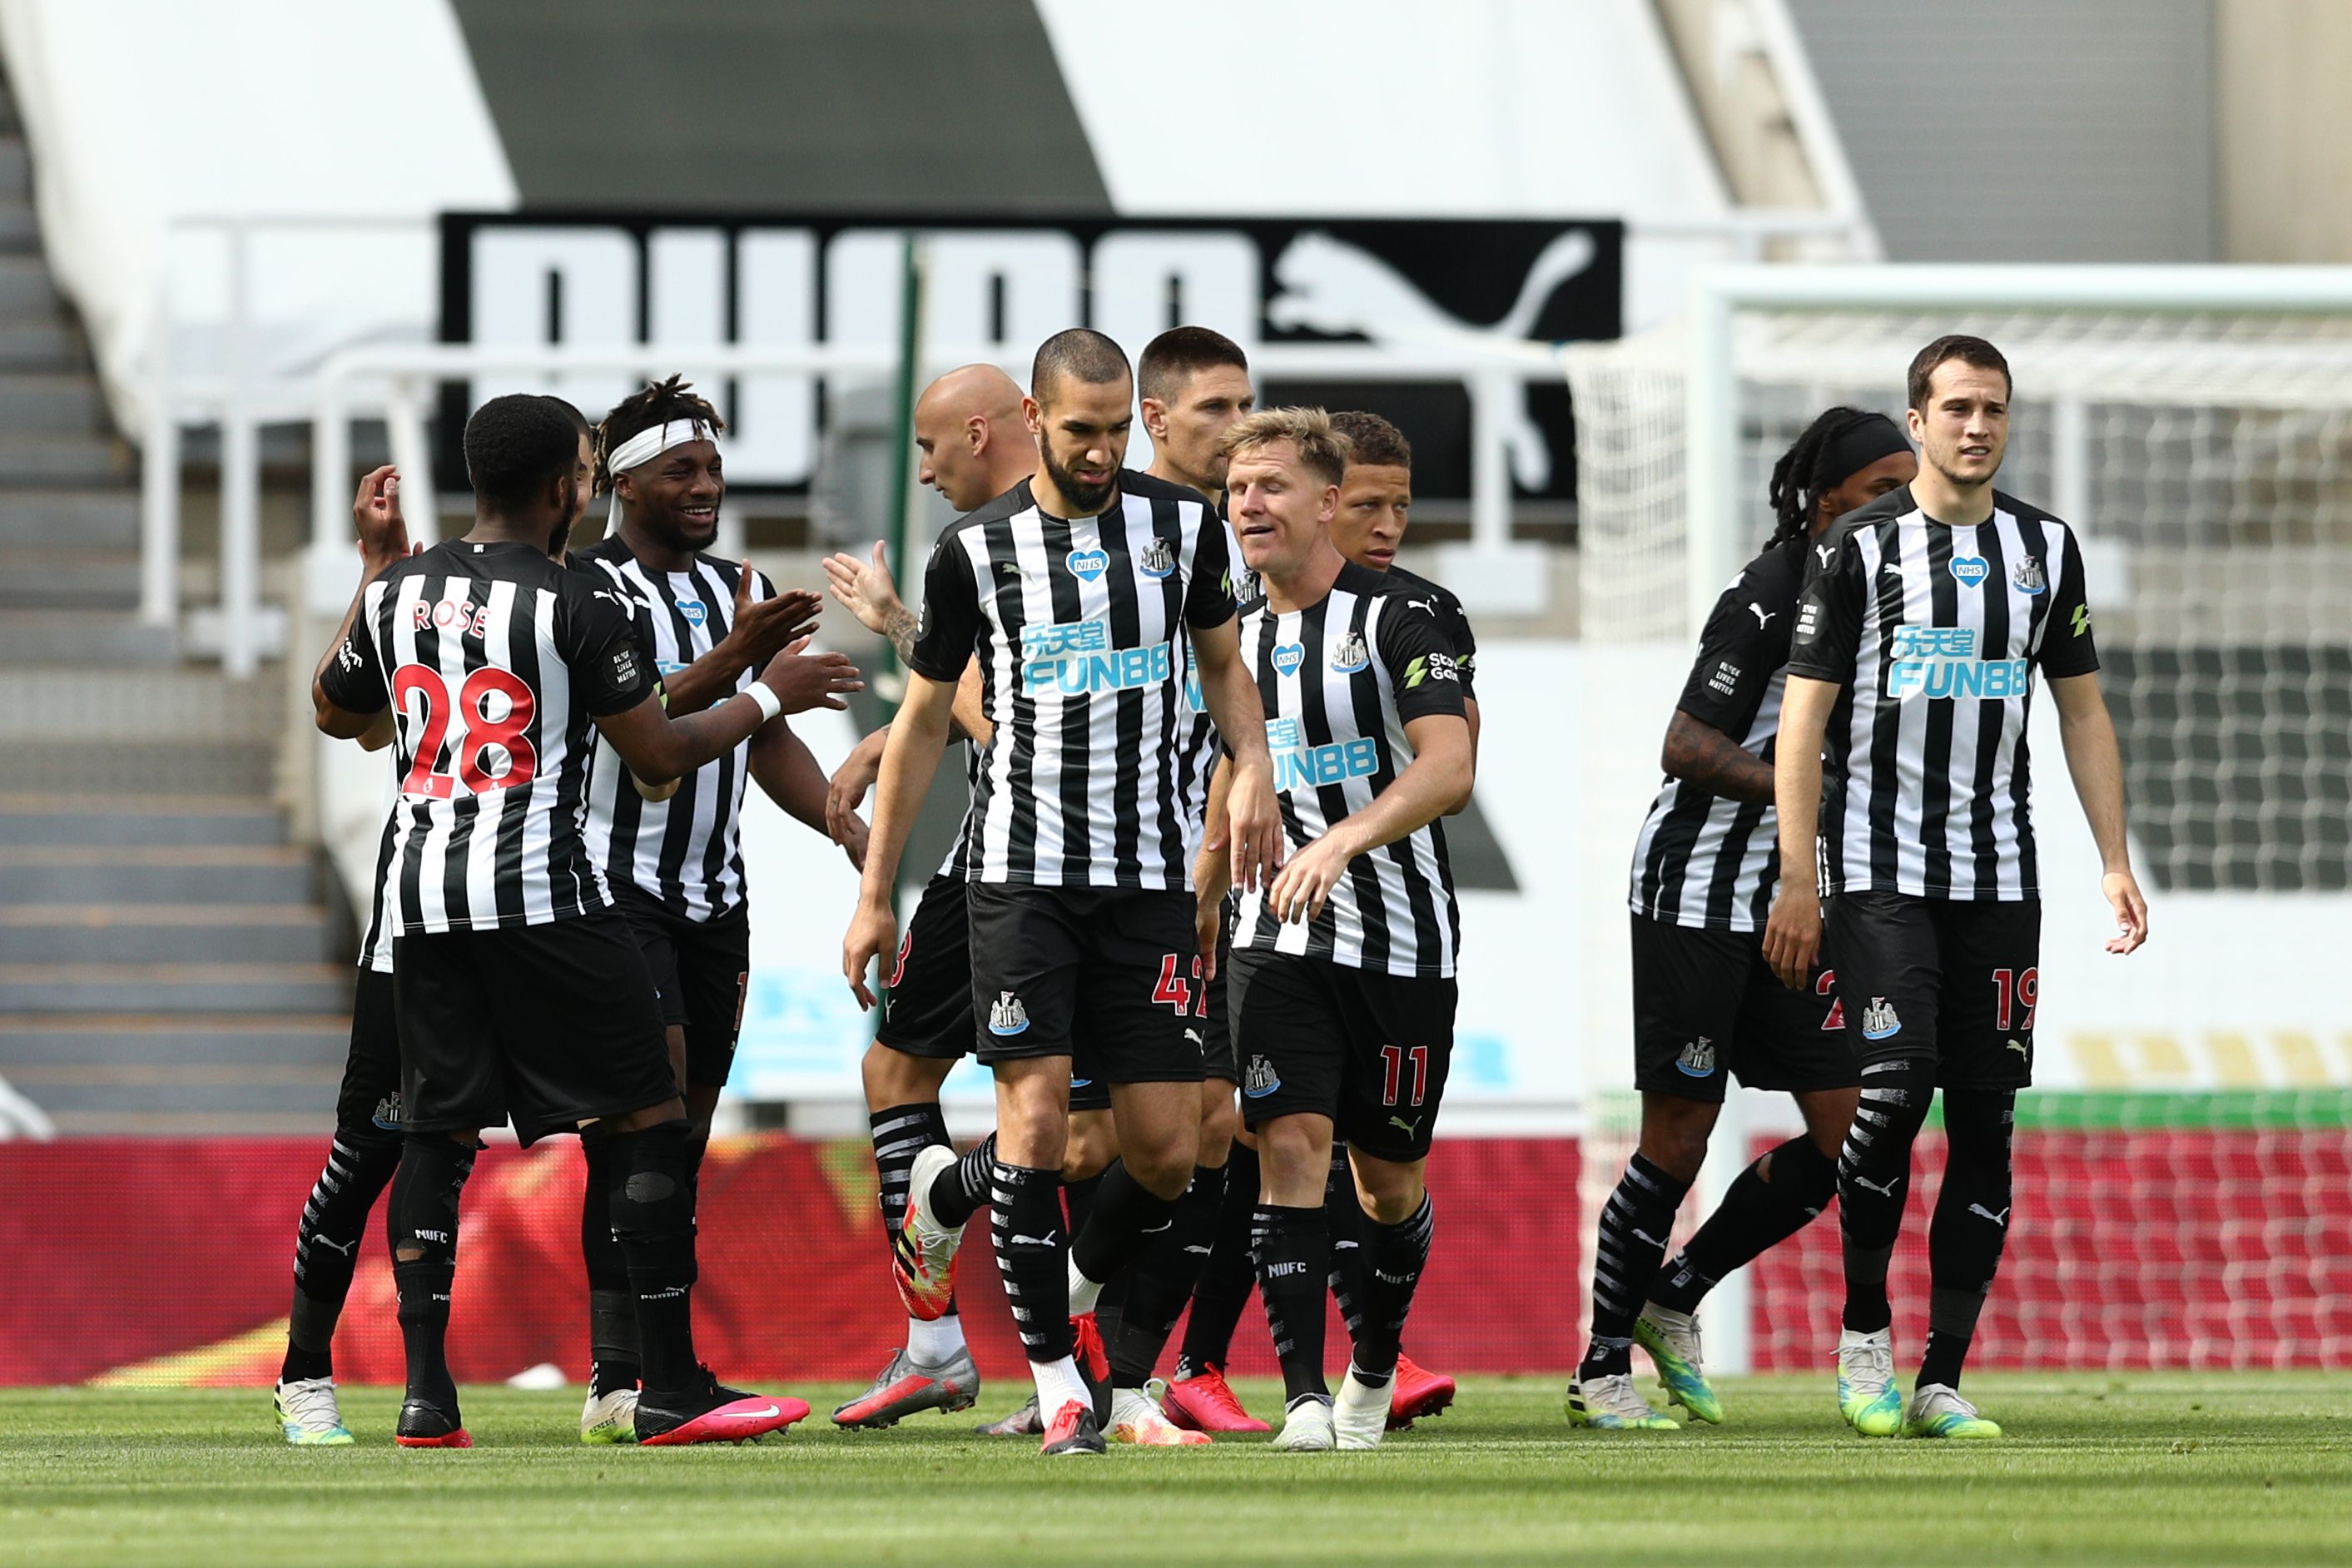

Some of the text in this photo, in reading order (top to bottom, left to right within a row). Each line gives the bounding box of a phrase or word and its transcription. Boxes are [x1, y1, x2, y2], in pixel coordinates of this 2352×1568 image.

[1076, 560, 1101, 569] NHS
[1958, 566, 1981, 575] NHS
[413, 600, 491, 639] ROSE
[682, 608, 701, 618] NHS
[1022, 643, 1169, 695] FUN88
[1278, 654, 1298, 665] NHS
[1889, 661, 2026, 697] FUN88
[392, 663, 537, 800] 28
[1273, 738, 1377, 789] UN88
[1992, 966, 2038, 1030] 19
[1380, 1045, 1427, 1107] 11
[415, 1229, 448, 1244] NUFC
[1268, 1262, 1307, 1278] NUFC
[1375, 1260, 1416, 1284] NUFC
